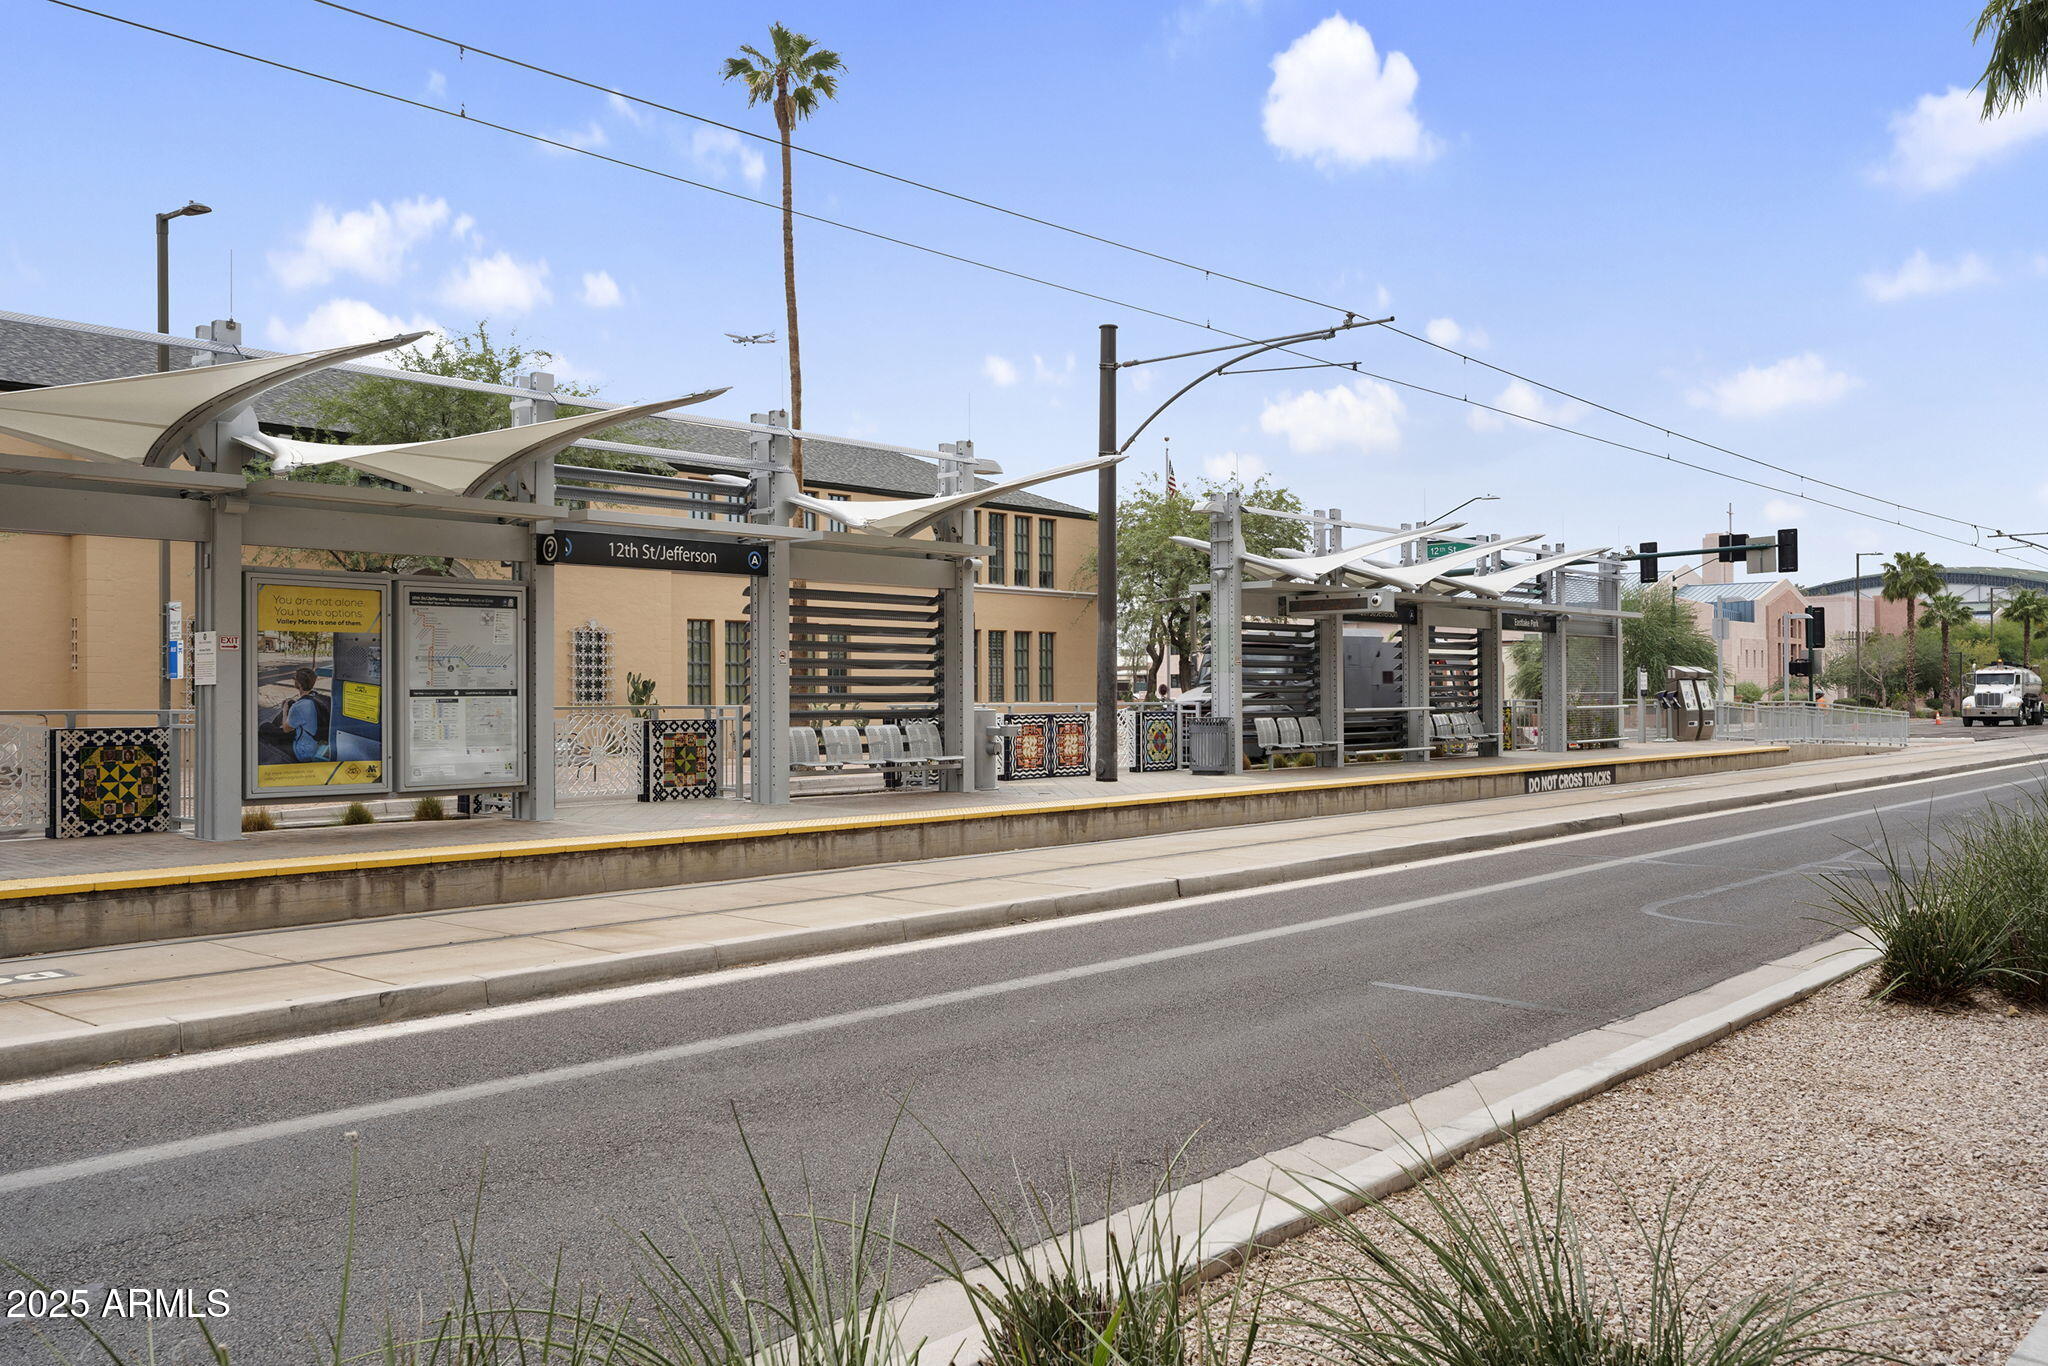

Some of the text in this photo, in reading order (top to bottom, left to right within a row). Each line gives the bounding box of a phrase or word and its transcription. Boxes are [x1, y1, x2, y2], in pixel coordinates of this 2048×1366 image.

[608, 542, 717, 564] 12th St/Jefferson
[1447, 545, 1457, 554] St
[273, 595, 365, 607] You are not alone.
[275, 606, 363, 619] You have options.
[1528, 770, 1612, 793] DO NOT CROSS TRACKS
